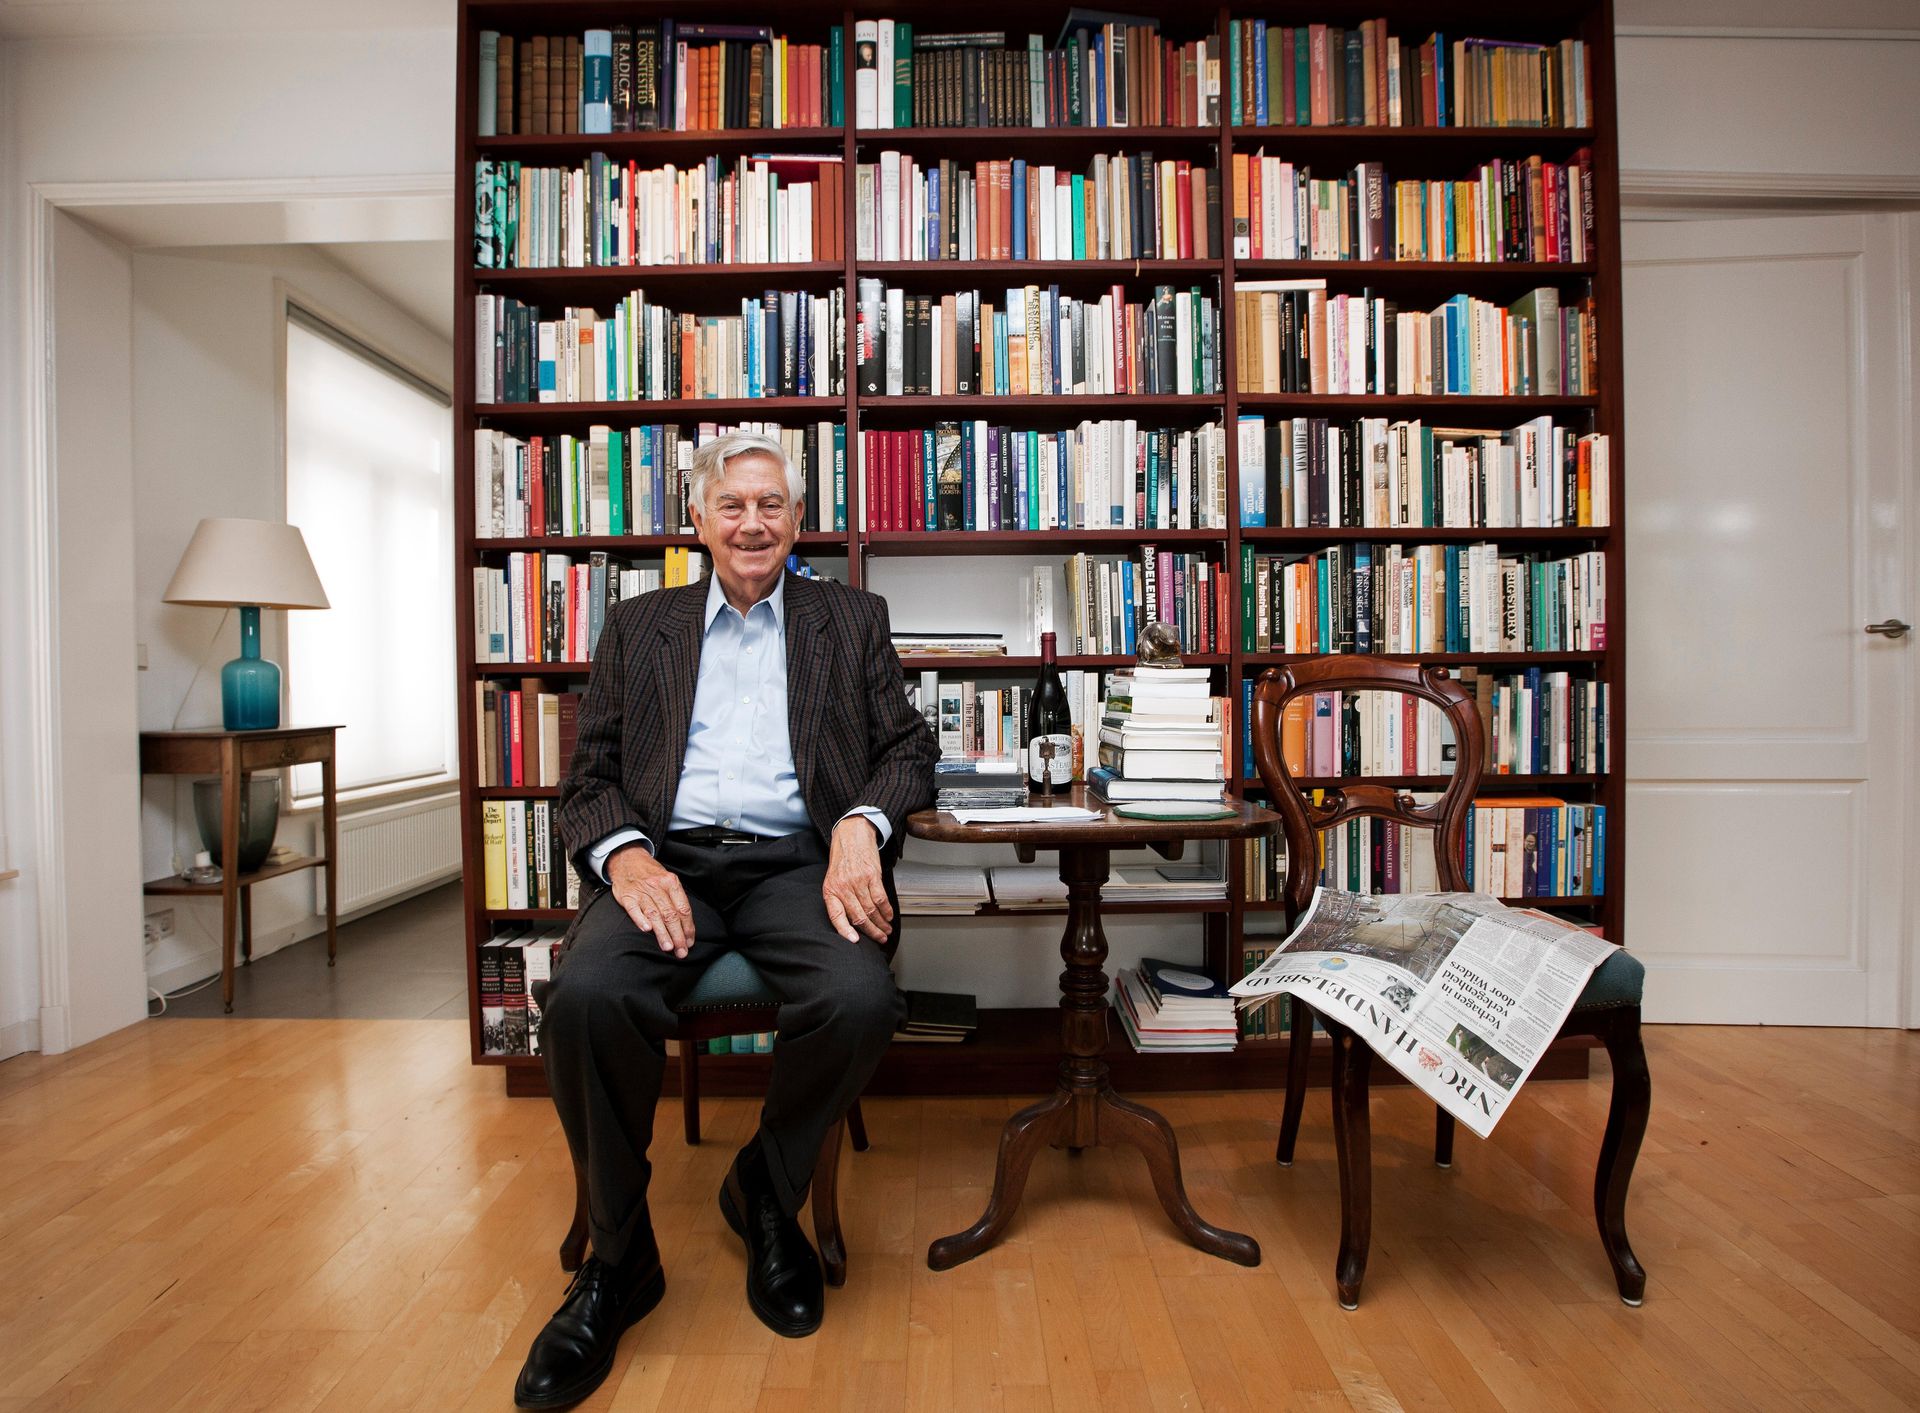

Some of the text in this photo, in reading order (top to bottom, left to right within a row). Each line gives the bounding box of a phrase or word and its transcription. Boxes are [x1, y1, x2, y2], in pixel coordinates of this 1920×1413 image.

[619, 43, 630, 104] RADICAL
[638, 41, 648, 104] CONTESTED
[896, 59, 911, 86] KANT
[1369, 178, 1378, 219] ERASMUS
[857, 323, 865, 366] REVOLUTION
[684, 447, 693, 469] Daniel
[925, 433, 934, 459] physics
[1295, 433, 1307, 473] JOHNSON
[926, 475, 935, 499] beyond
[1259, 585, 1267, 616] Austrian
[1356, 596, 1365, 618] SIÈCLE
[1507, 572, 1517, 634] BIG STORY
[1441, 983, 1453, 996] in
[1441, 969, 1509, 1018] verlegenheid
[1450, 960, 1489, 993] Wilders
[1246, 974, 1418, 1055] HANDELSBLAD
[1453, 992, 1500, 1030] Verhagen
[1489, 986, 1516, 1008] door
[1438, 1064, 1500, 1118] NRC
